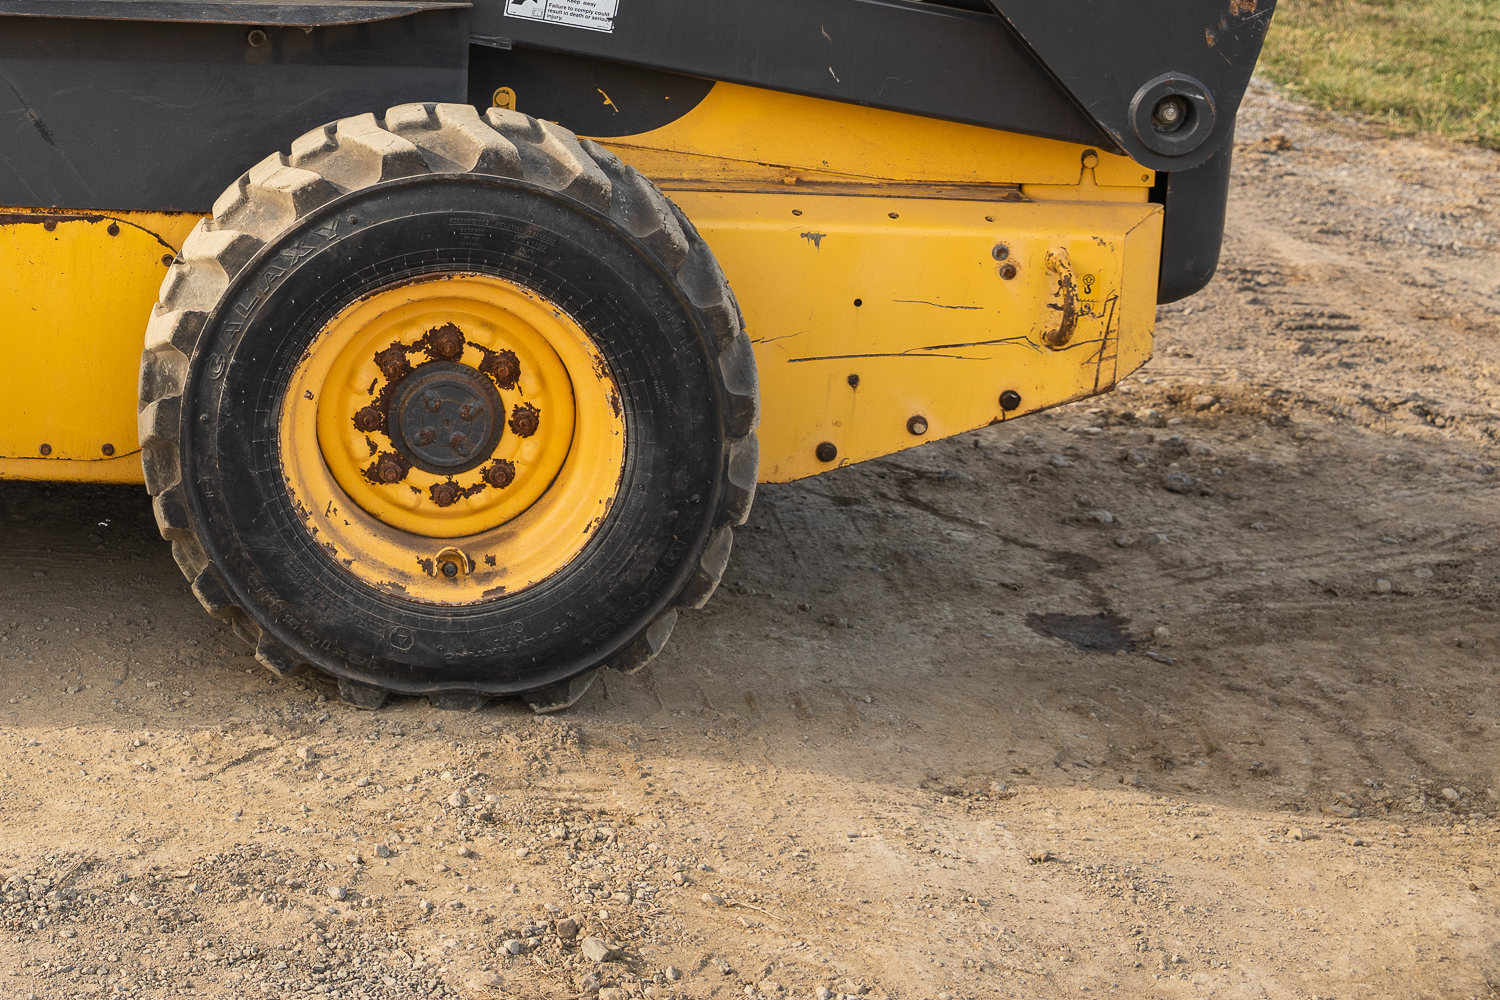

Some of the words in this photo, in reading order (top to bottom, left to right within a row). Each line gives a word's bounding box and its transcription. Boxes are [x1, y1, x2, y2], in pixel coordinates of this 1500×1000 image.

[548, 2, 567, 10] Failure
[574, 7, 594, 15] comply
[206, 216, 342, 380] GALAXY
